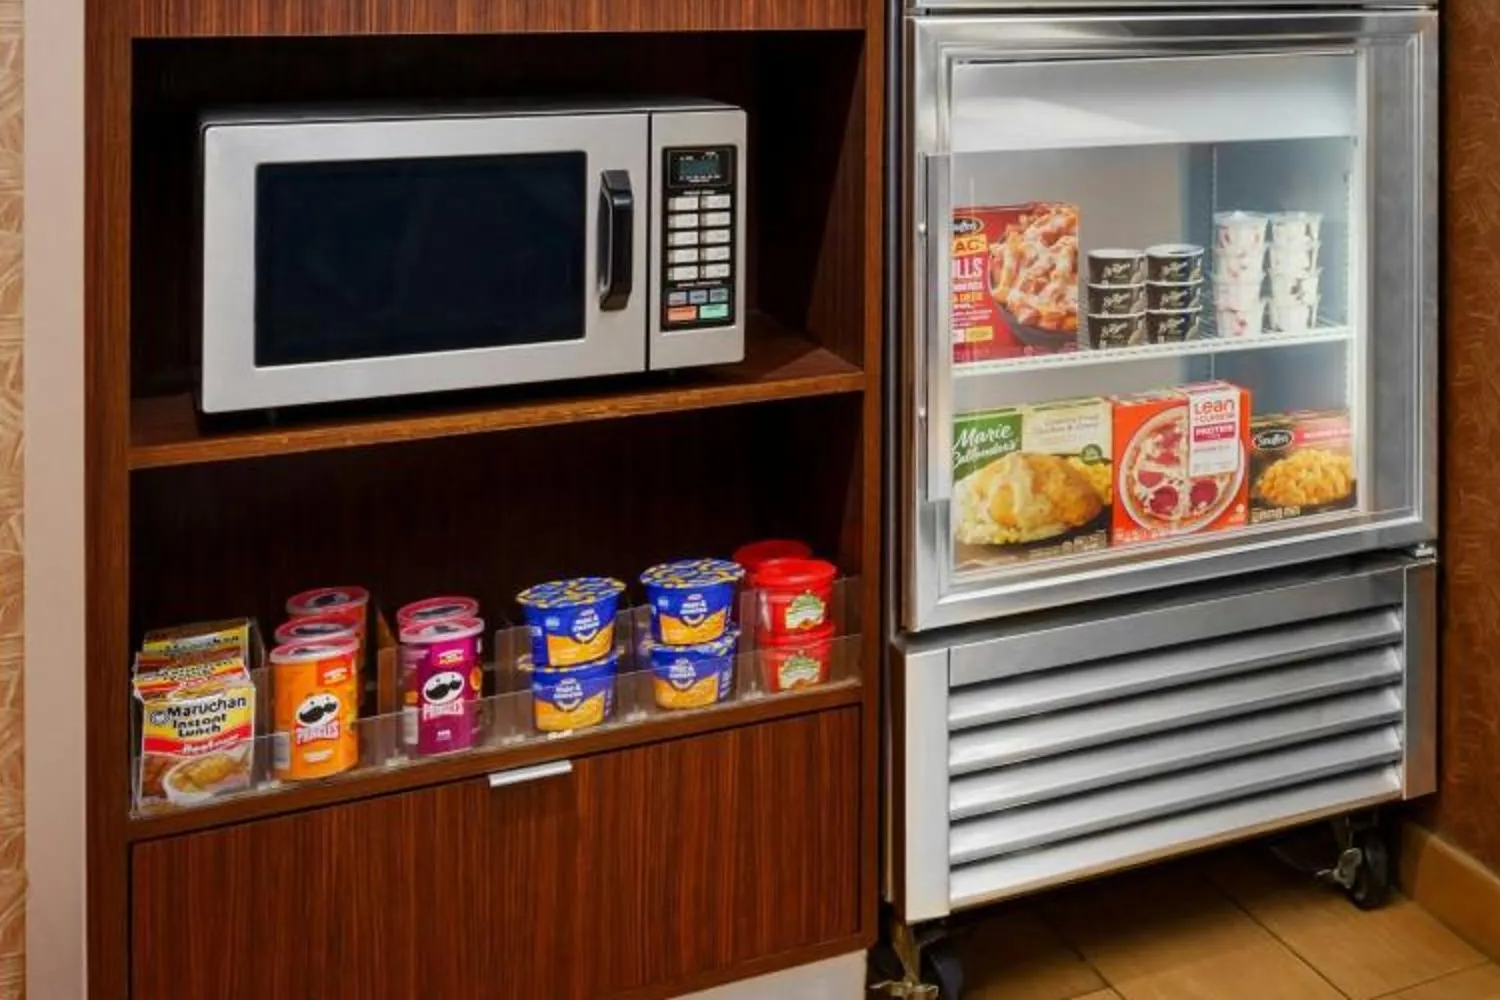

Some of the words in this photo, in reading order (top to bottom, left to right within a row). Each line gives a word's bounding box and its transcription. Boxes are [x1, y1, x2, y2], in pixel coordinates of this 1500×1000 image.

[1195, 399, 1234, 415] Lean
[952, 424, 1014, 449] Marie
[167, 697, 247, 717] Maruchan
[172, 713, 227, 729] Instant
[178, 724, 221, 738] Lunch
